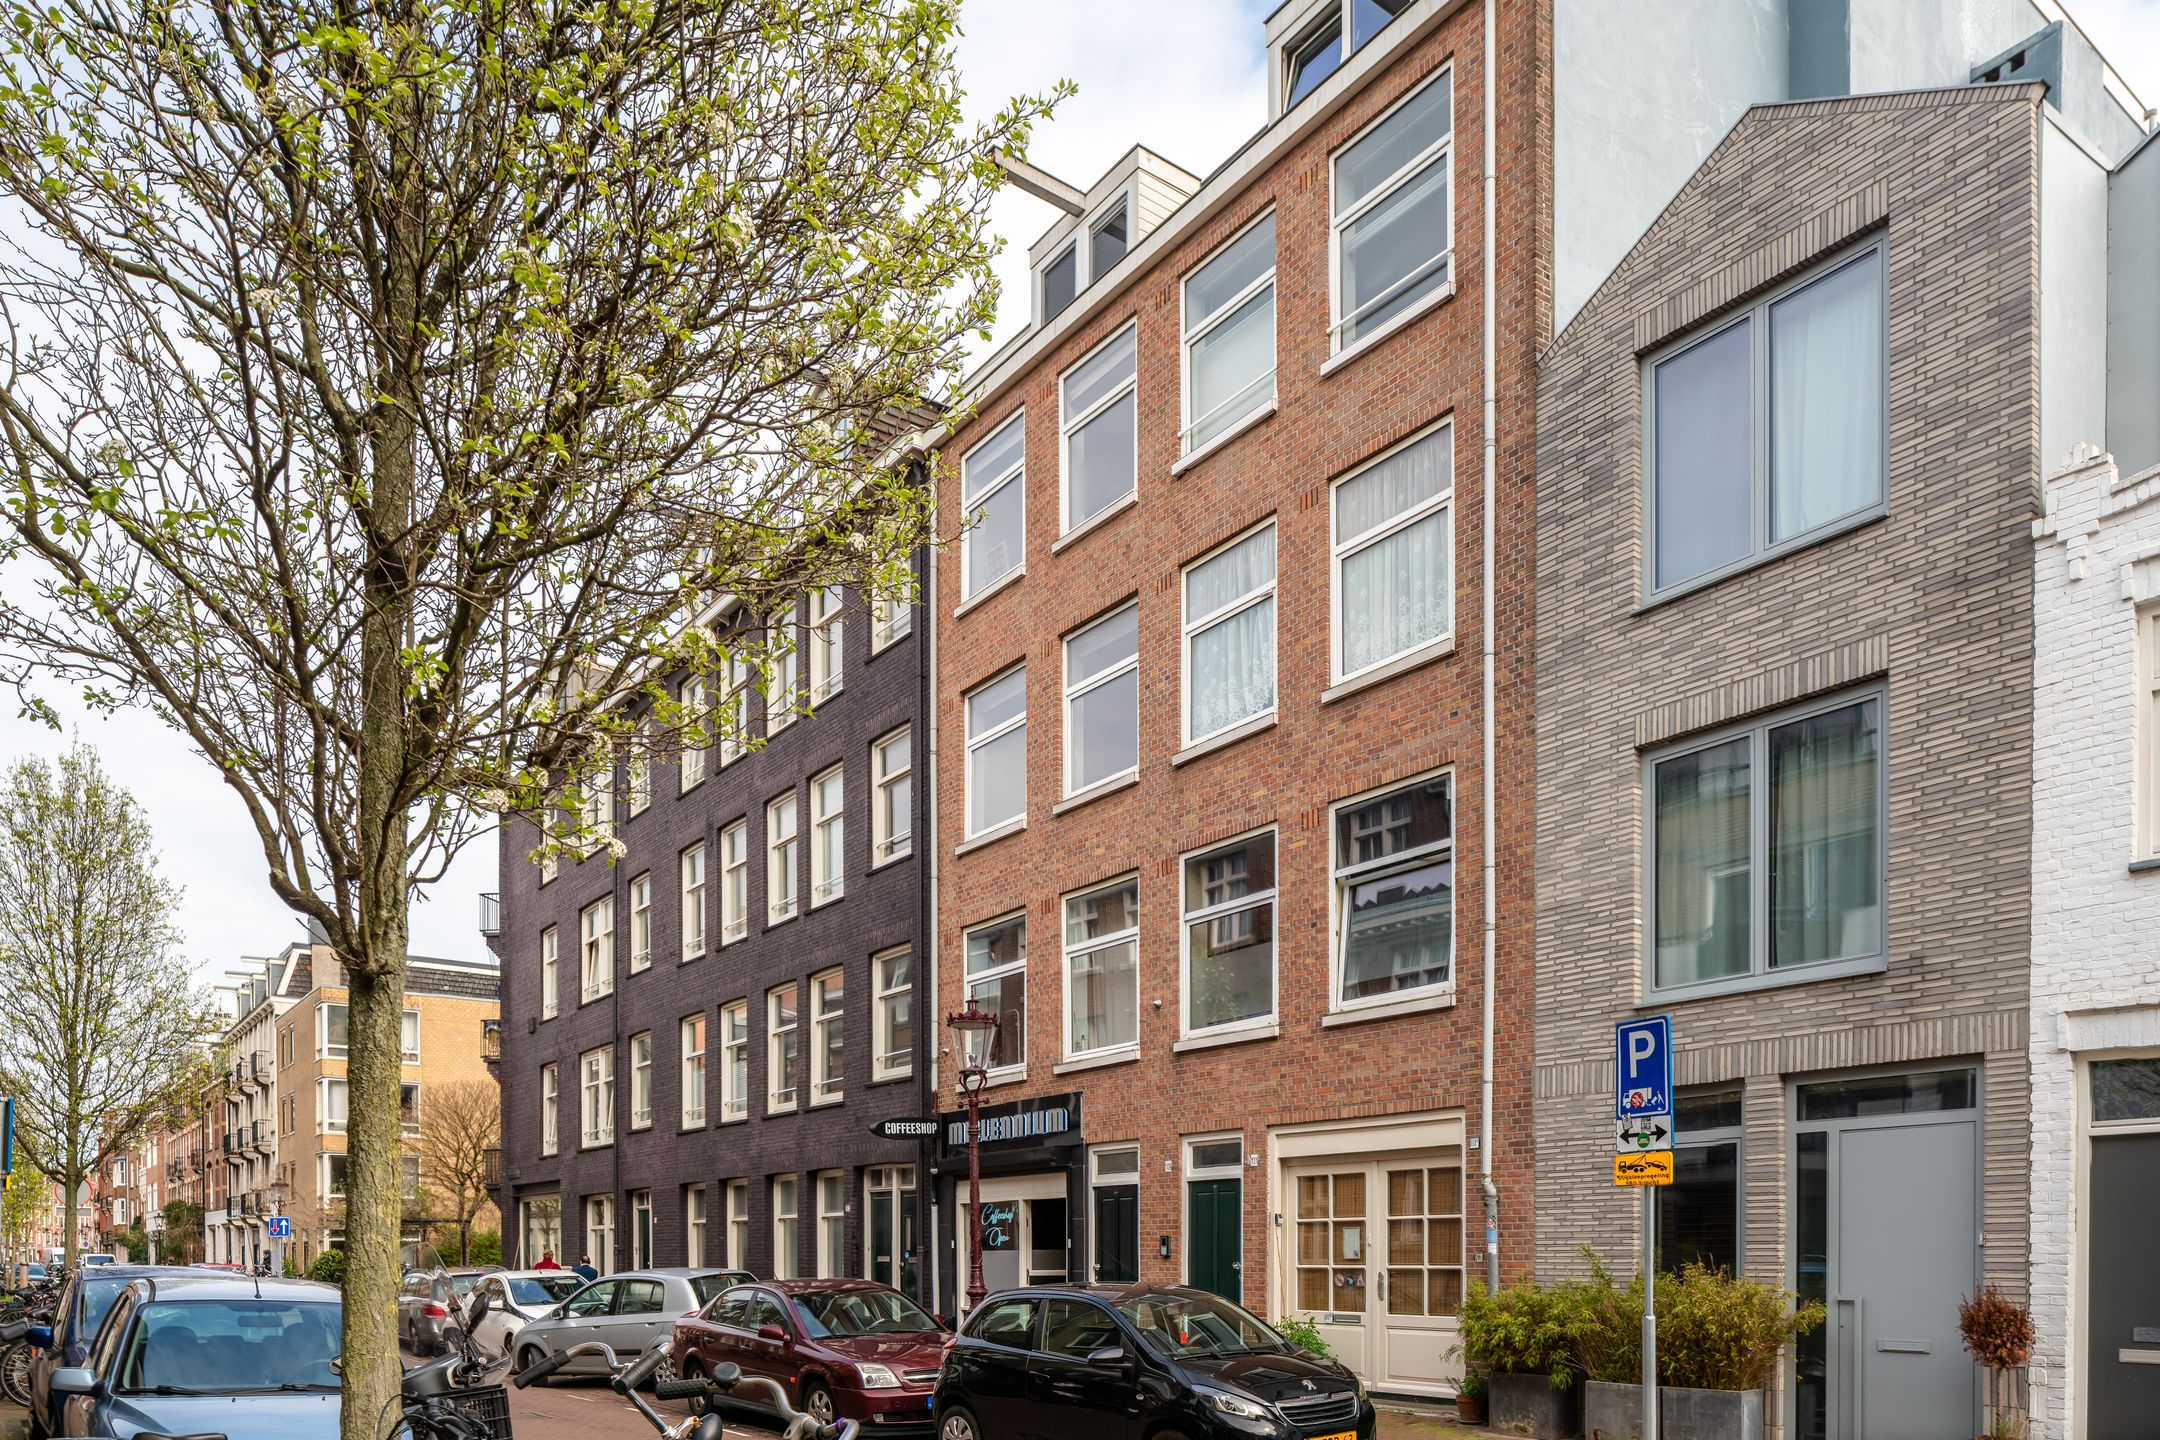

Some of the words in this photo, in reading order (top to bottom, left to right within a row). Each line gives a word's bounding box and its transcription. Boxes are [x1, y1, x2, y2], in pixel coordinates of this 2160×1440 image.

[1628, 1029, 1656, 1079] P
[884, 1122, 938, 1135] COFFEESHOP
[985, 1226, 1010, 1247] Open
